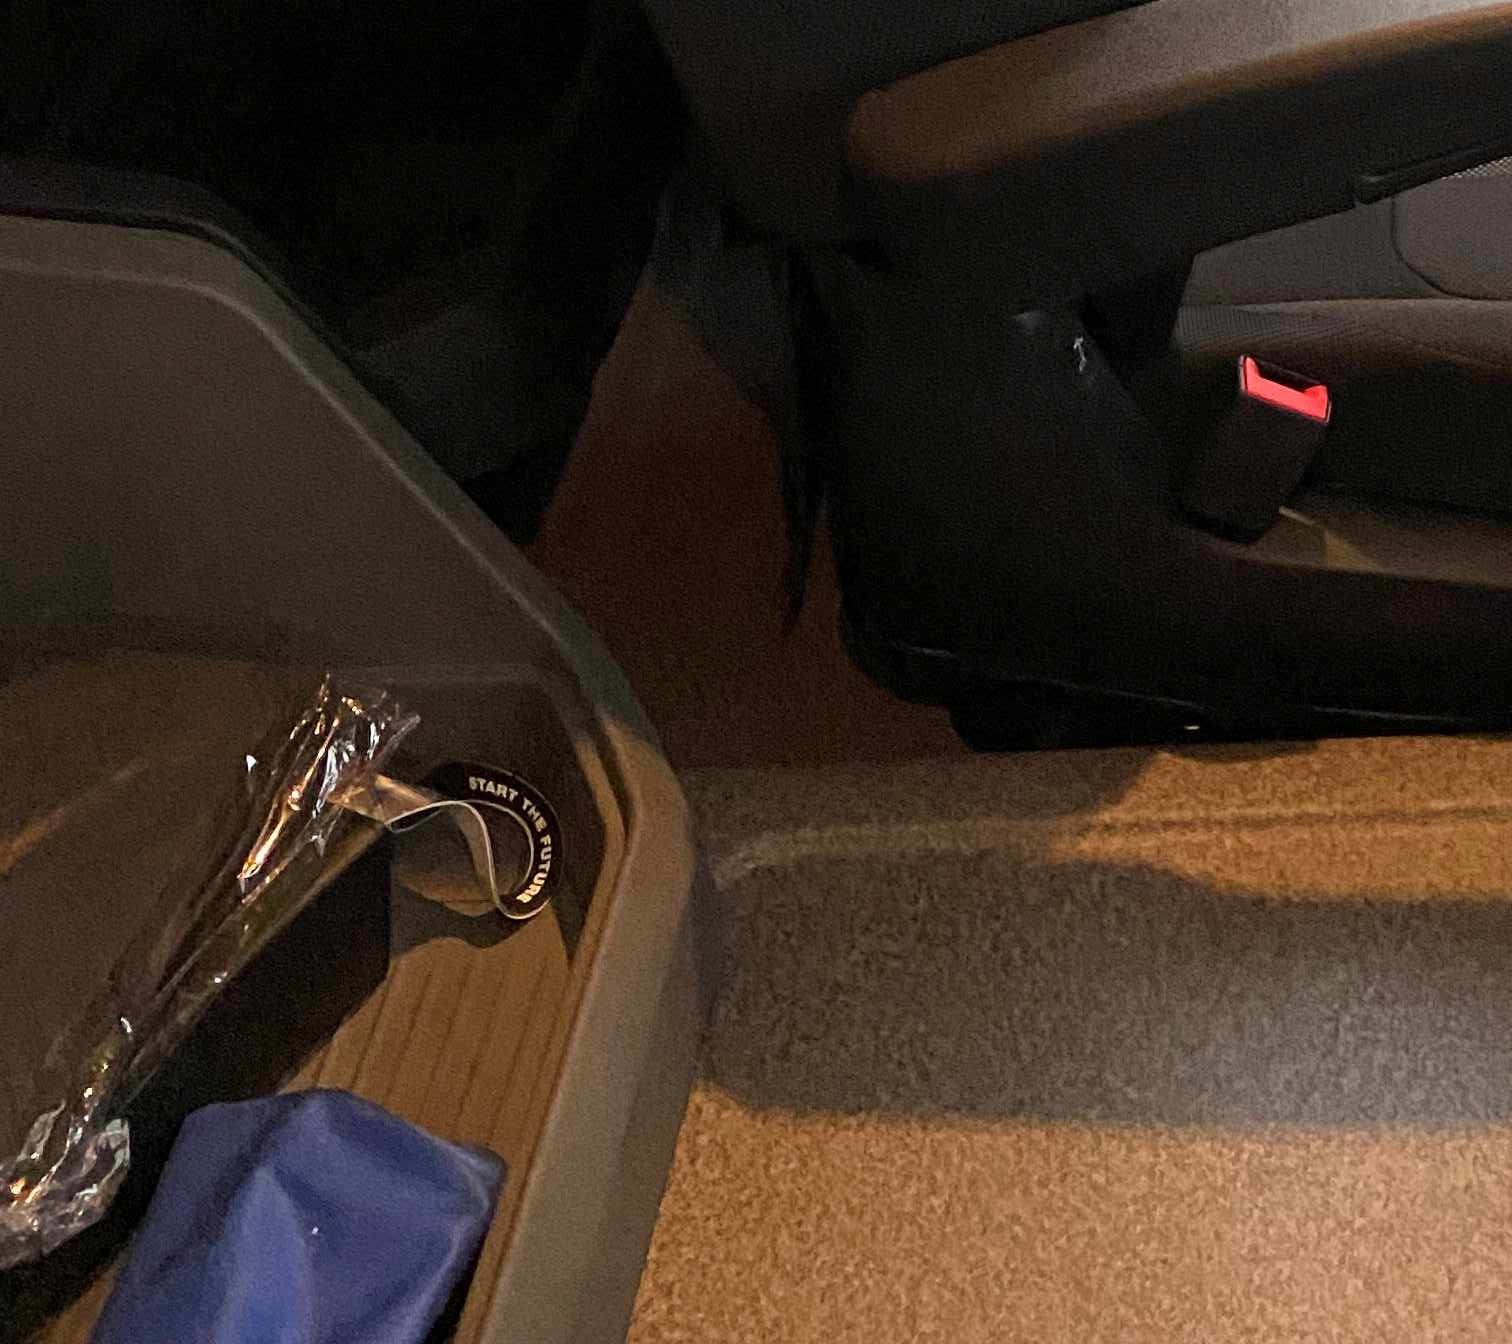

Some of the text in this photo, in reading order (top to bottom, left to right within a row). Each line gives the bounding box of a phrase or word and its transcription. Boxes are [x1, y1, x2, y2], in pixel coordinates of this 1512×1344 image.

[468, 776, 552, 904] START THE FUTURE
